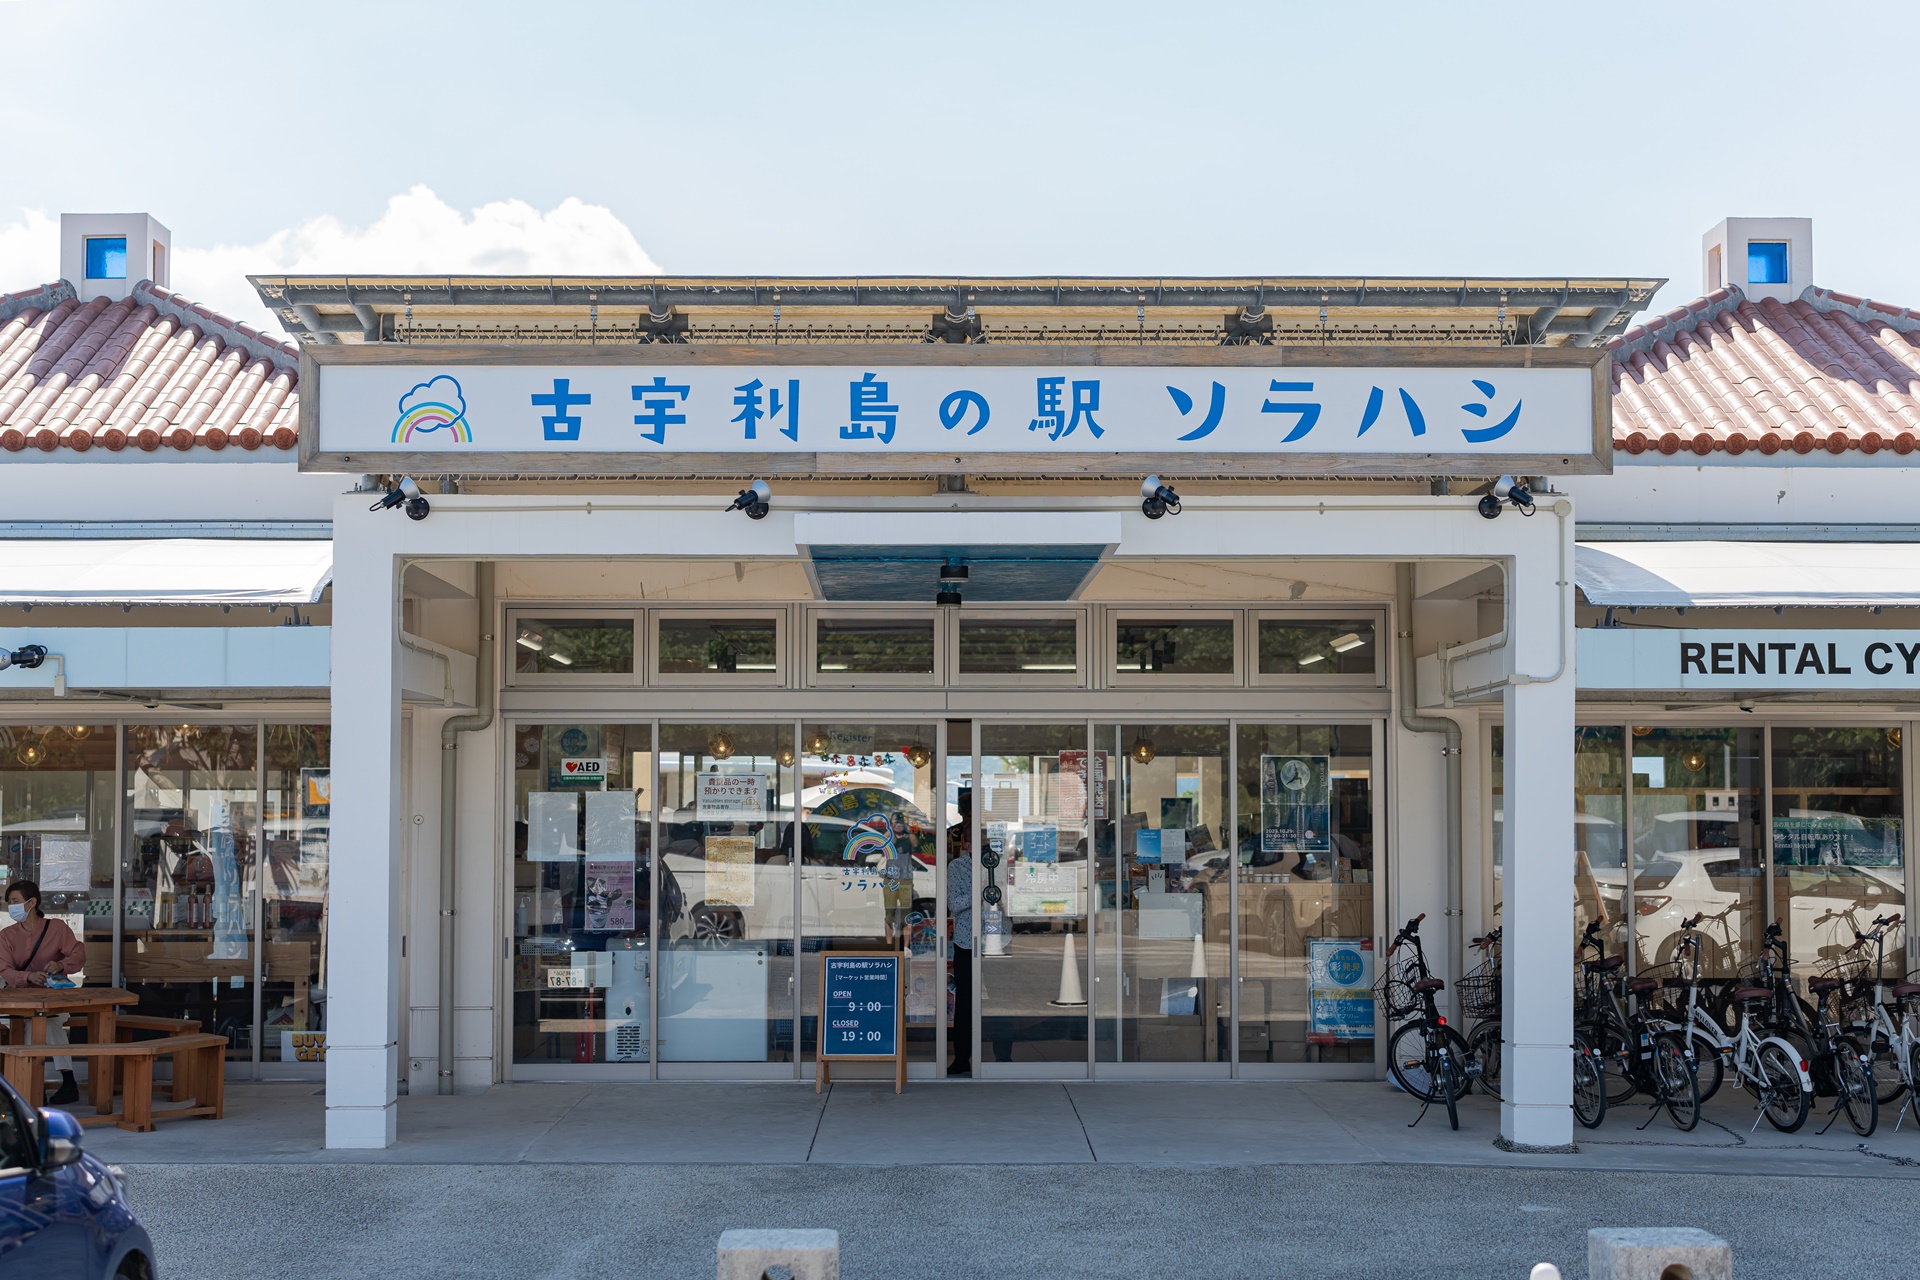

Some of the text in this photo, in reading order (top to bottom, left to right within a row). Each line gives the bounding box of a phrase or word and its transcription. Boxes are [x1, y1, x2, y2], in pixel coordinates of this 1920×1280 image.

[532, 372, 1521, 444] 古宇利島の駅 ソラハシ
[1681, 642, 1920, 675] RENTAL CY
[829, 730, 872, 743] Register
[577, 762, 600, 772] AED
[708, 778, 755, 786] 貴重品の一時
[1076, 757, 1087, 808] できます
[704, 787, 759, 795] 預かりできます
[1793, 842, 1816, 850] bicycles
[1025, 872, 1059, 884] 冷房中
[841, 879, 900, 891] ソラハシ
[610, 918, 625, 926] 580
[292, 1033, 326, 1047] BUY
[841, 1031, 881, 1041] 19:00
[295, 1047, 326, 1062] GET
